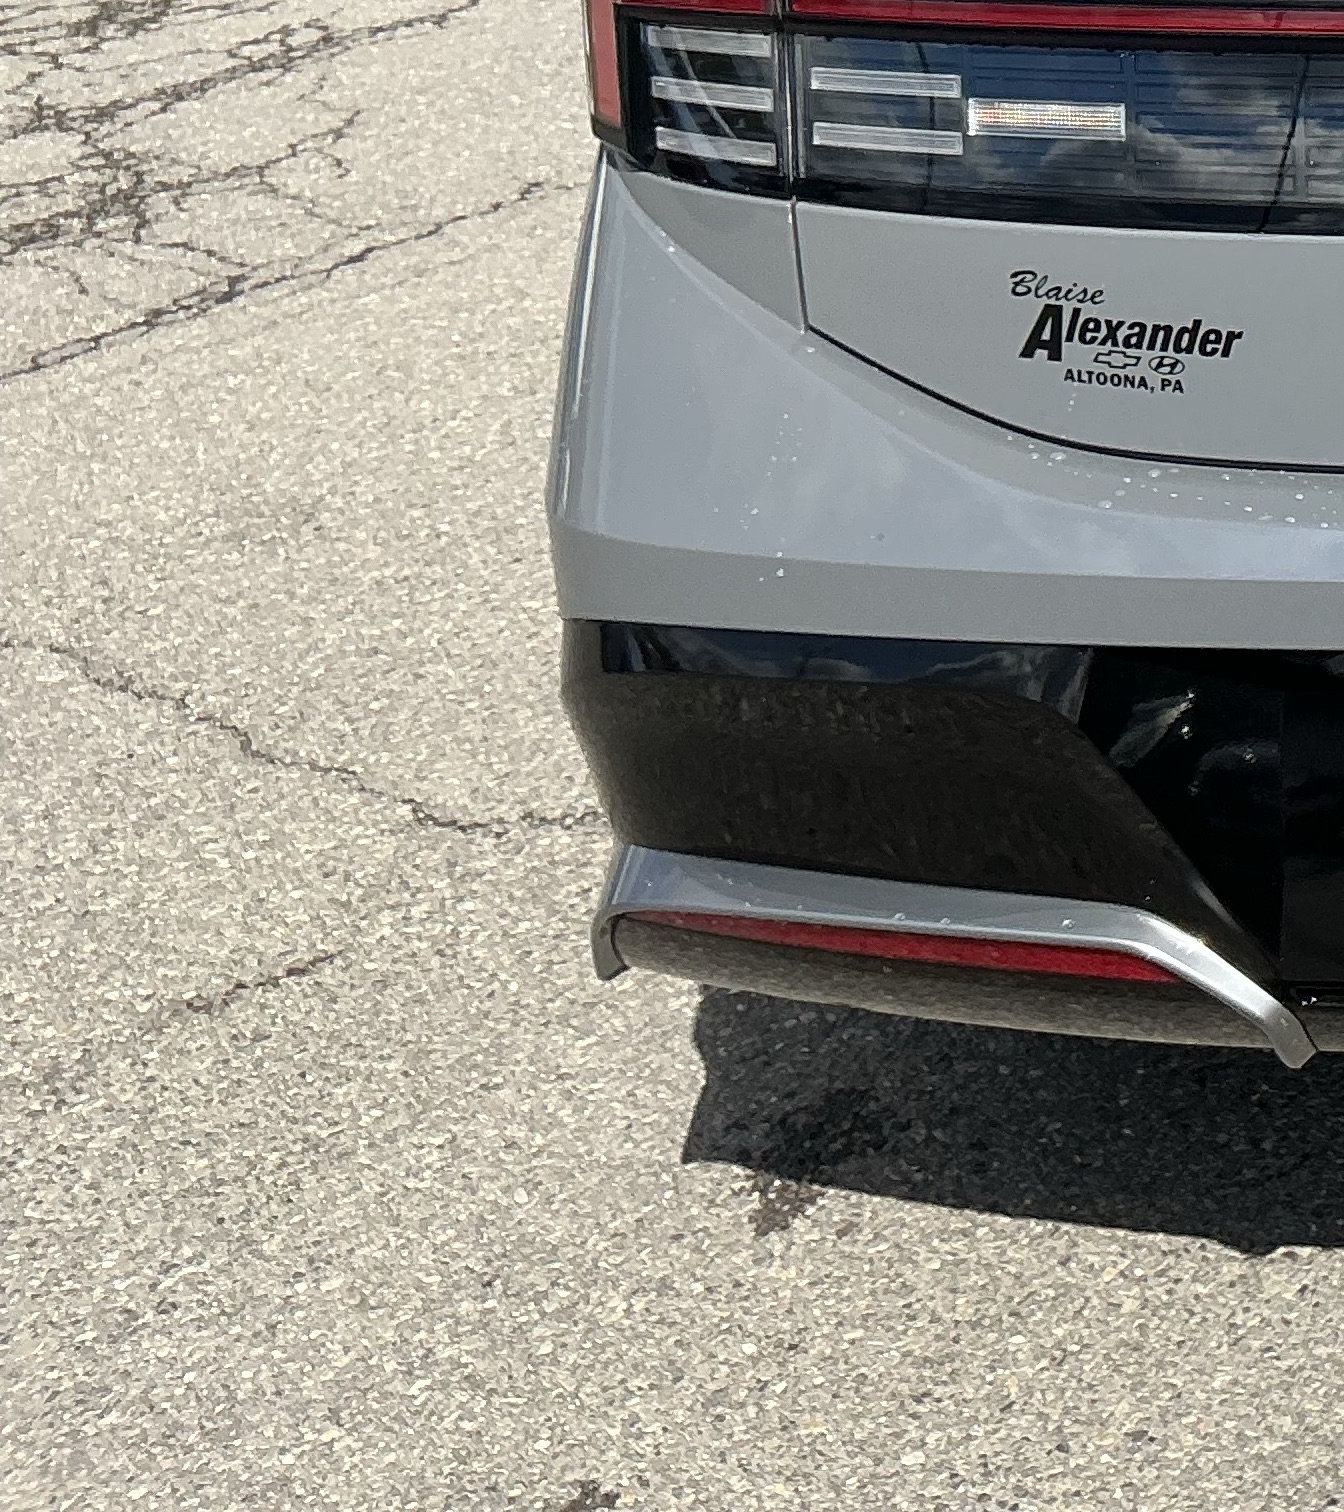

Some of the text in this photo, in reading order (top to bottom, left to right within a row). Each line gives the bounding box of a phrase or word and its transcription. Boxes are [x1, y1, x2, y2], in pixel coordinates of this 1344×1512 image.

[1009, 269, 1106, 306] Blaise
[1018, 302, 1245, 363] Alexander
[1063, 367, 1185, 395] ALTOONA, PA
